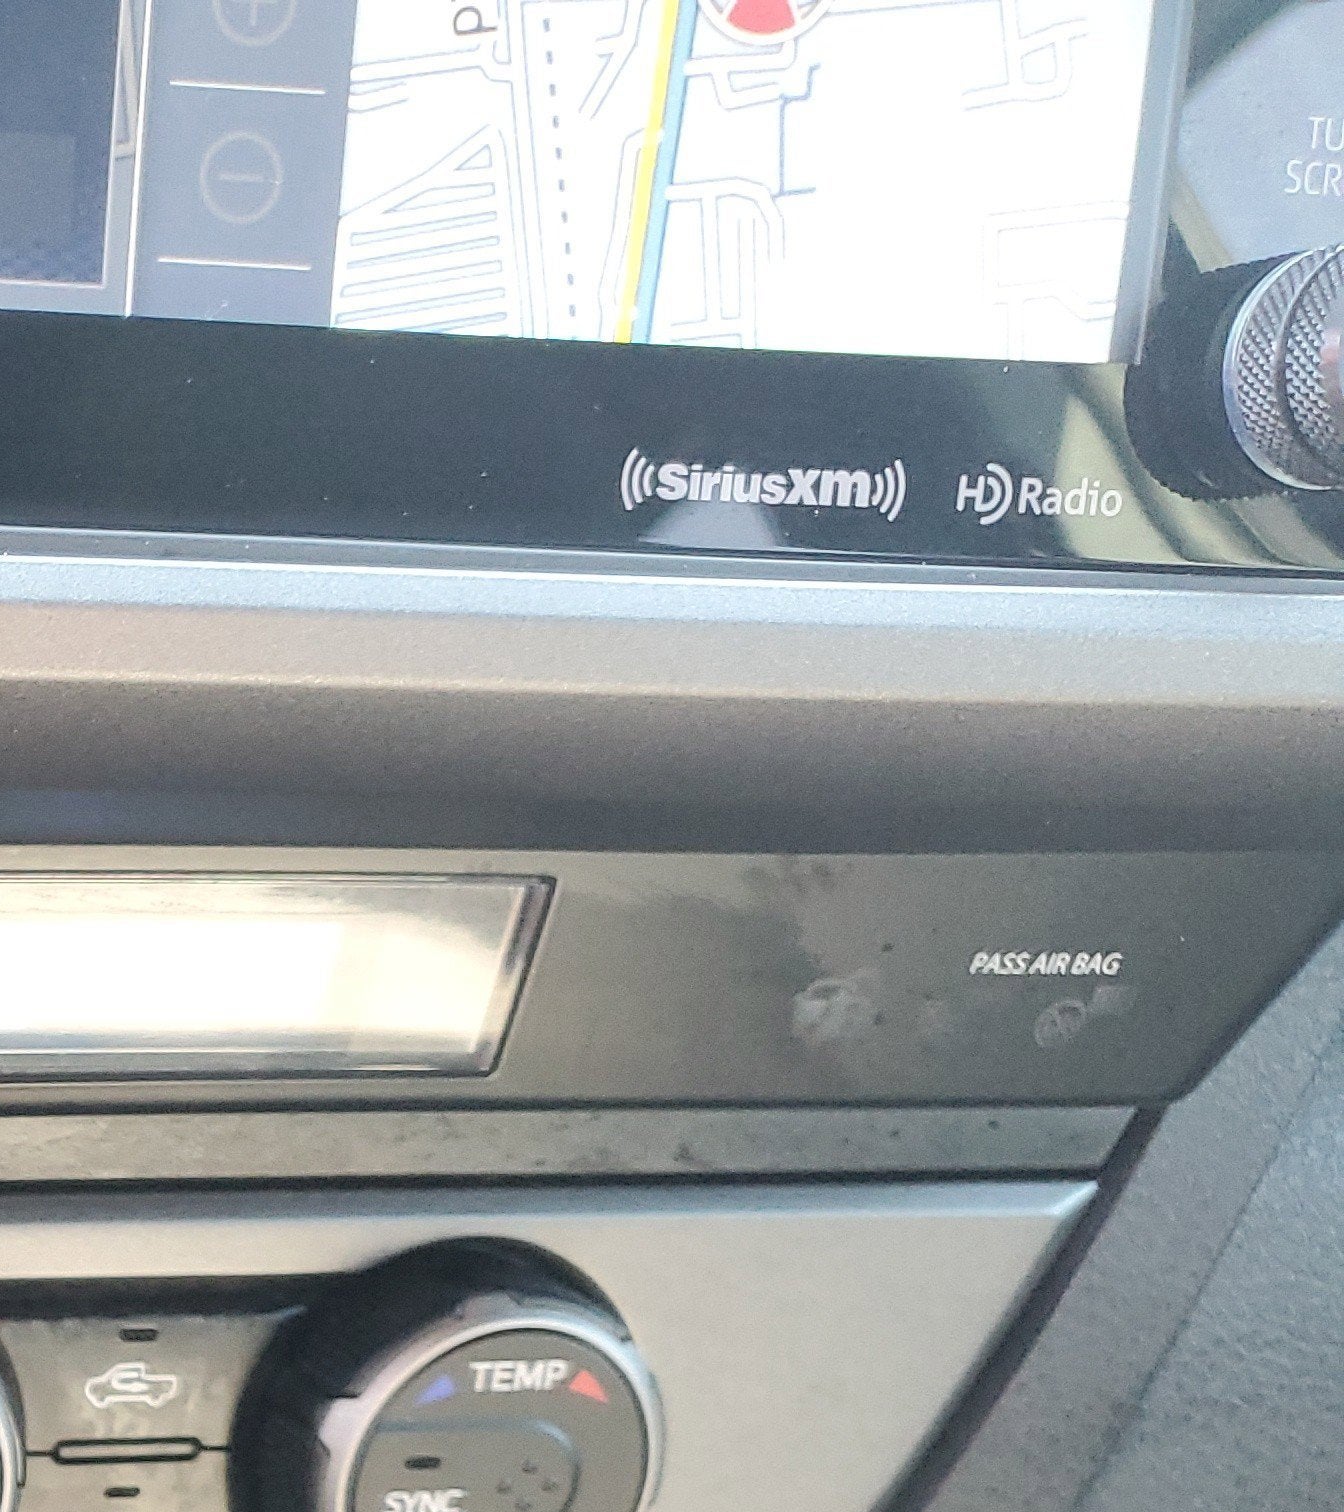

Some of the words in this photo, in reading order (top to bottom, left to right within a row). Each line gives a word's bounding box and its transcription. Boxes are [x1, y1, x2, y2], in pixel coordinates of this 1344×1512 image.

[1016, 475, 1124, 518] Radio
[968, 951, 1032, 976] PASS
[1028, 951, 1071, 976] AIR
[1070, 950, 1125, 977] BAG
[468, 1358, 570, 1393] TEMP
